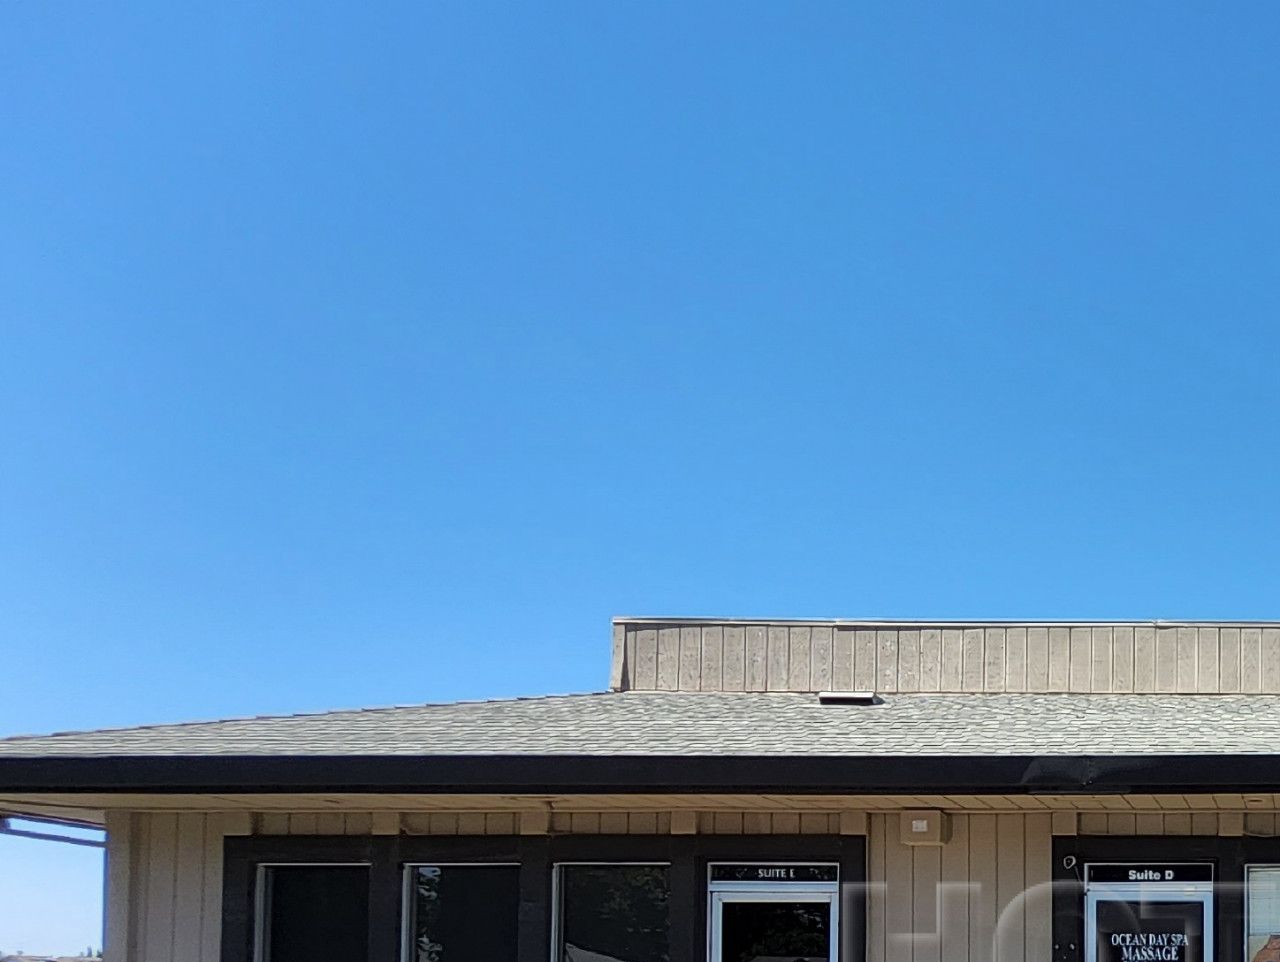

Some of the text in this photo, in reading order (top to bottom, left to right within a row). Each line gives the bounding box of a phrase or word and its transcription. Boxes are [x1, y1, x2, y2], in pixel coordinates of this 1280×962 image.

[758, 869, 787, 878] SUITE
[1128, 869, 1174, 880] Suite D
[1111, 933, 1147, 946] OCEAN
[1170, 933, 1189, 946] SPA
[1121, 946, 1179, 961] MASSAGE
